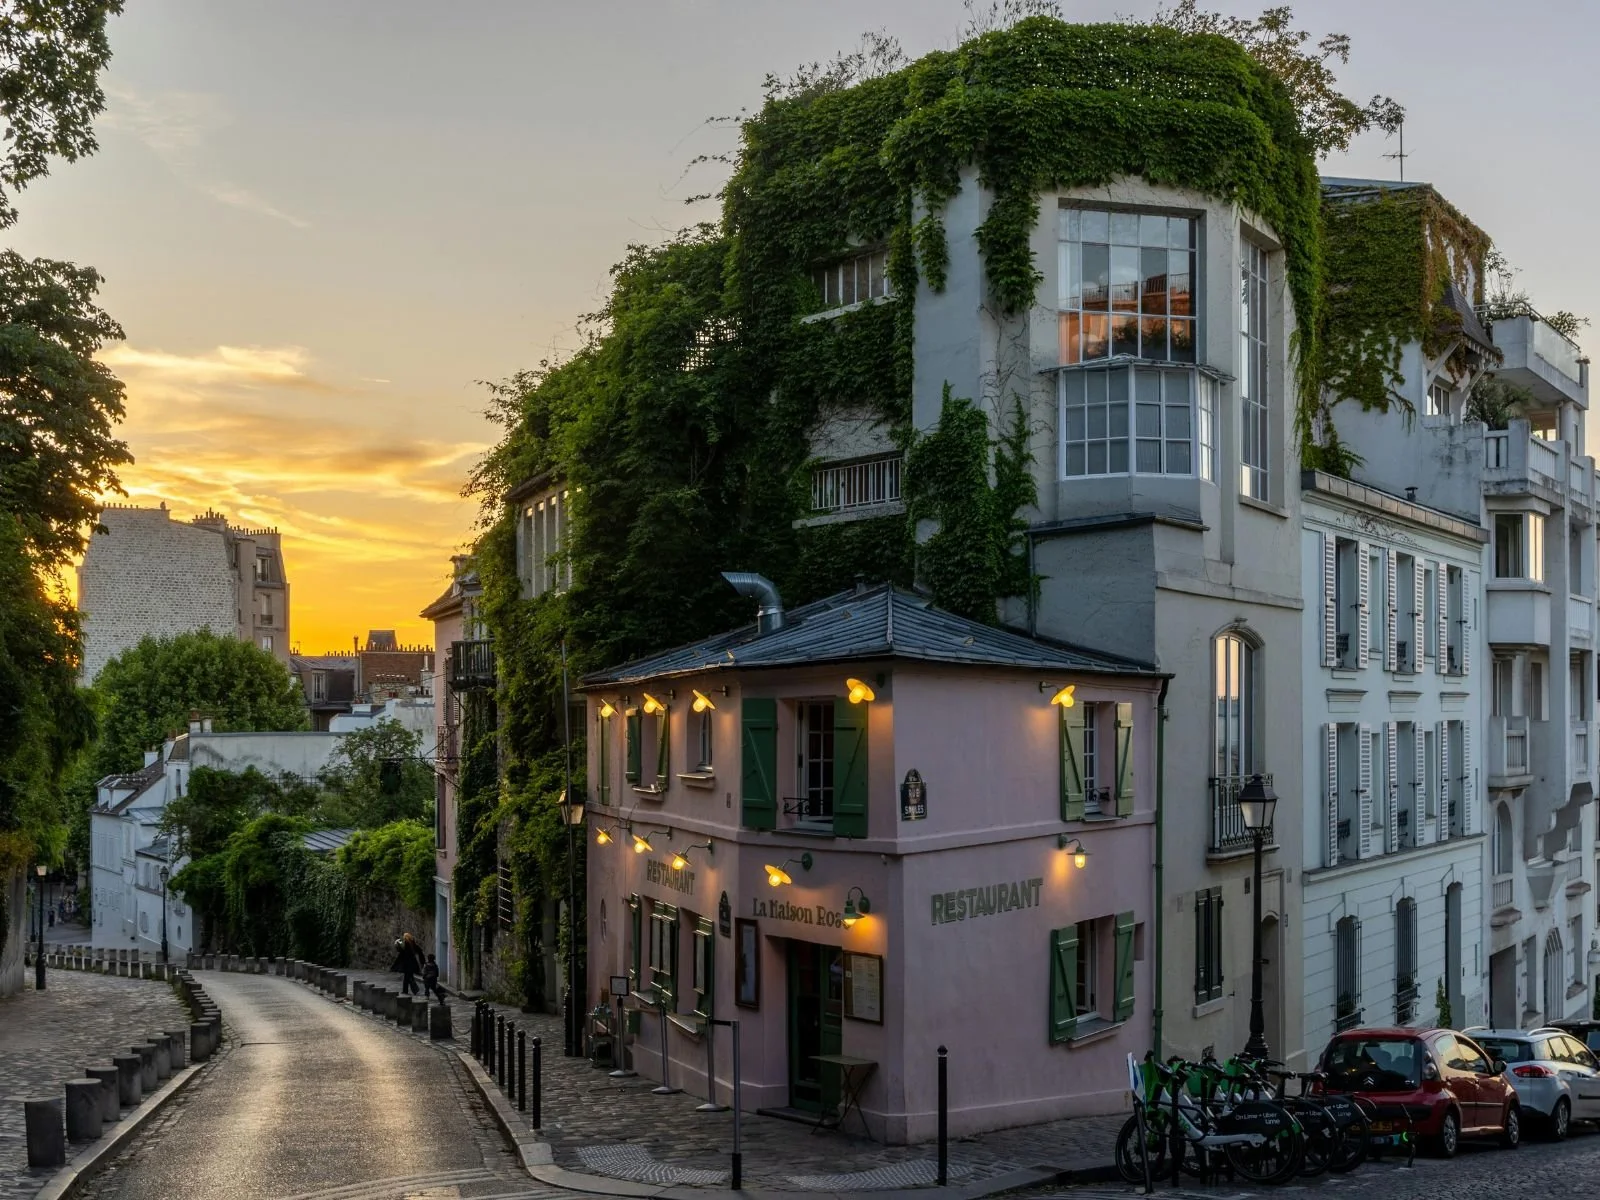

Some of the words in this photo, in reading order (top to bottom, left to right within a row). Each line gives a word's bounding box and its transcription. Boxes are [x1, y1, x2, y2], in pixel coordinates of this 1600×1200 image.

[647, 859, 695, 896] RESTAURANT
[753, 898, 767, 917] La
[770, 899, 813, 925] Maison
[931, 878, 1043, 926] RESTAURANT
[1262, 1111, 1277, 1119] Uber
[1265, 1118, 1281, 1126] Lime
